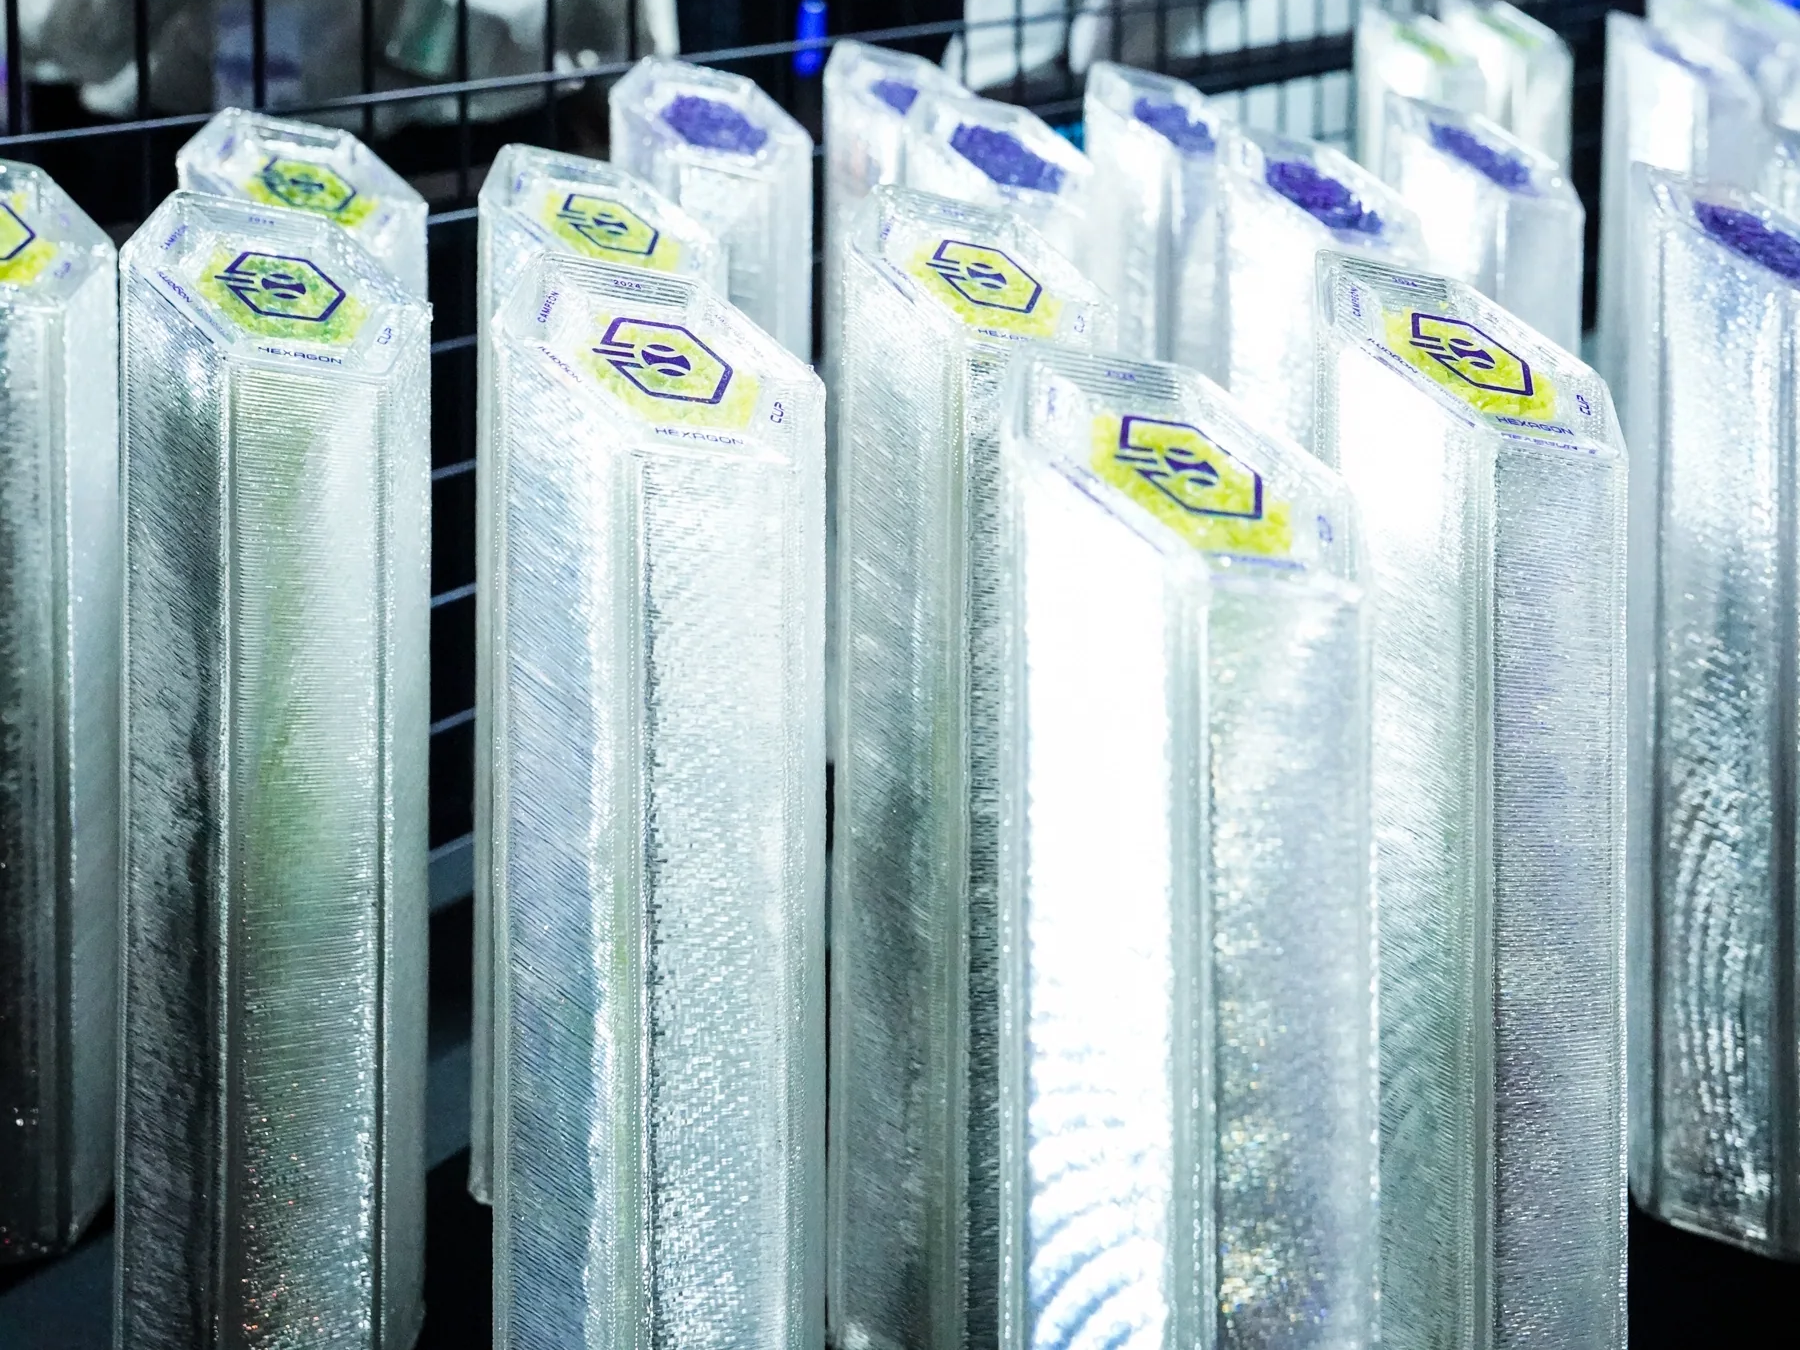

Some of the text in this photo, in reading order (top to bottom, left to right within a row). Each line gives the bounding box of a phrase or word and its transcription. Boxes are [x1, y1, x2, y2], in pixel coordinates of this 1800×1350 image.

[613, 279, 642, 290] 2024
[377, 327, 392, 345] CUP
[258, 346, 342, 365] HEXAGON
[770, 401, 784, 423] CUP
[1575, 394, 1592, 416] CUP
[1495, 415, 1575, 437] HEXAGON
[654, 427, 744, 445] HEXAGON
